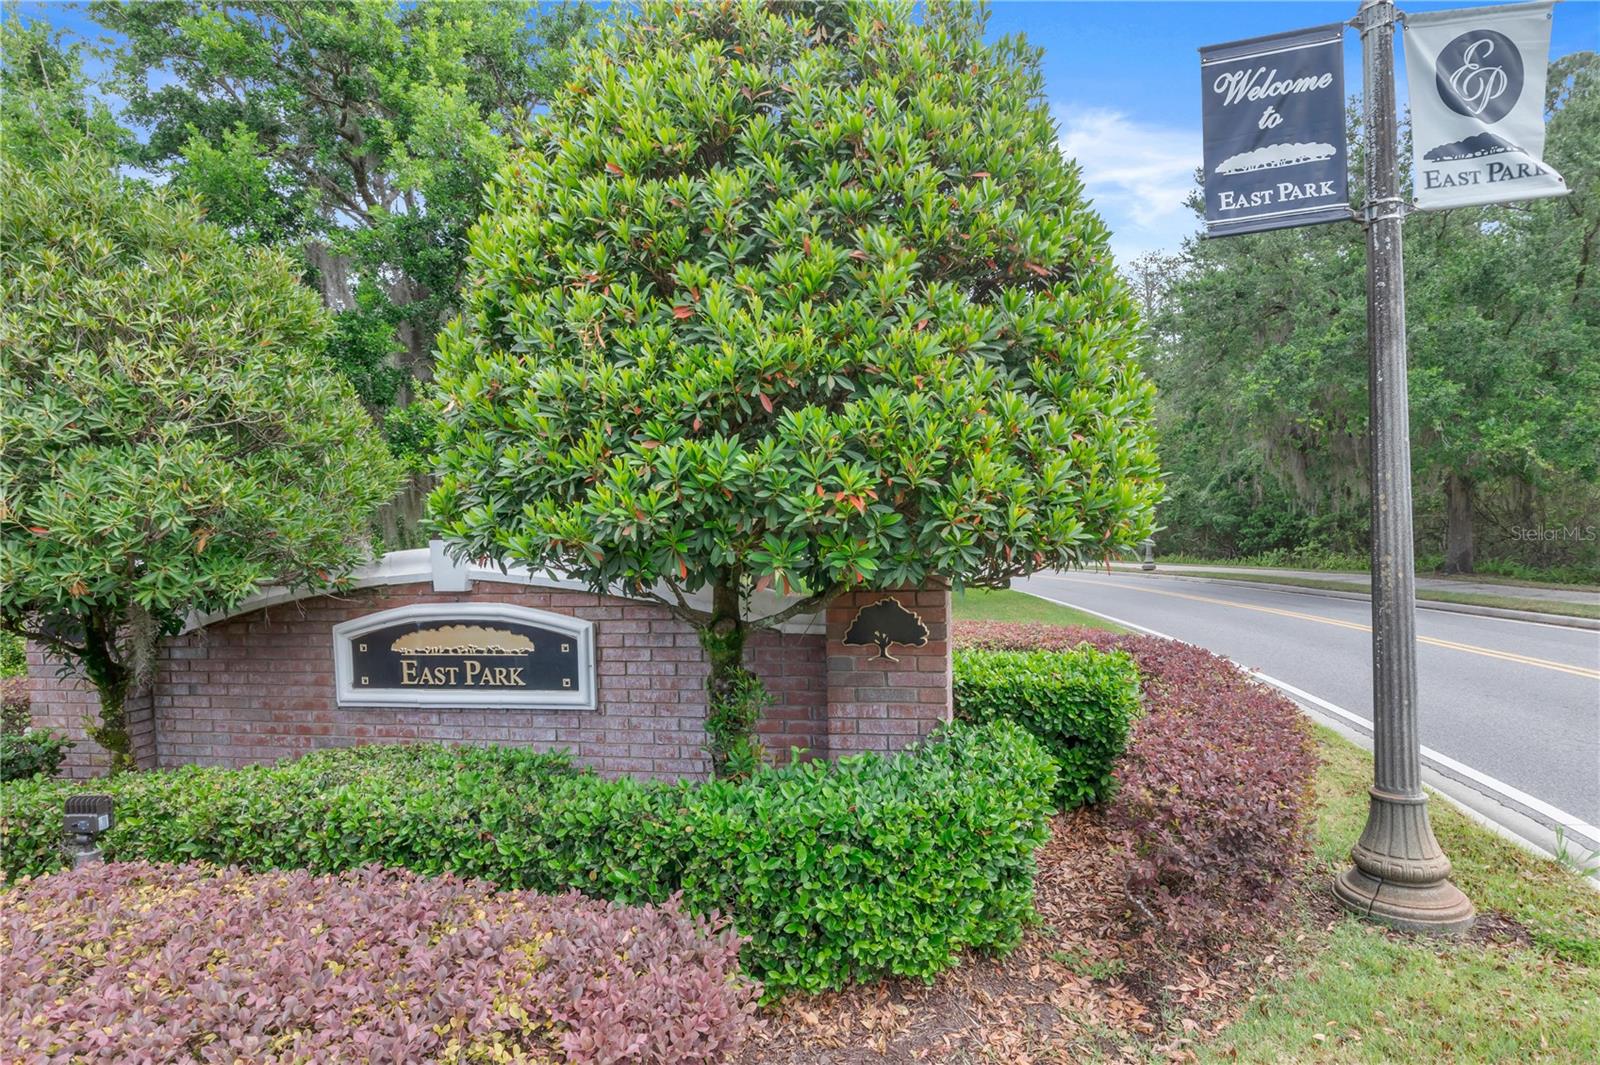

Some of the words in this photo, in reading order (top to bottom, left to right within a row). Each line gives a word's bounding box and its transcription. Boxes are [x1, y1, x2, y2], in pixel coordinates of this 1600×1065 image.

[1213, 67, 1332, 106] Welcome
[1257, 105, 1283, 130] to
[1423, 169, 1481, 190] EAST
[1218, 190, 1273, 211] EAST
[1277, 180, 1336, 202] PARK
[400, 660, 459, 685] EAST
[463, 660, 526, 686] PARK
